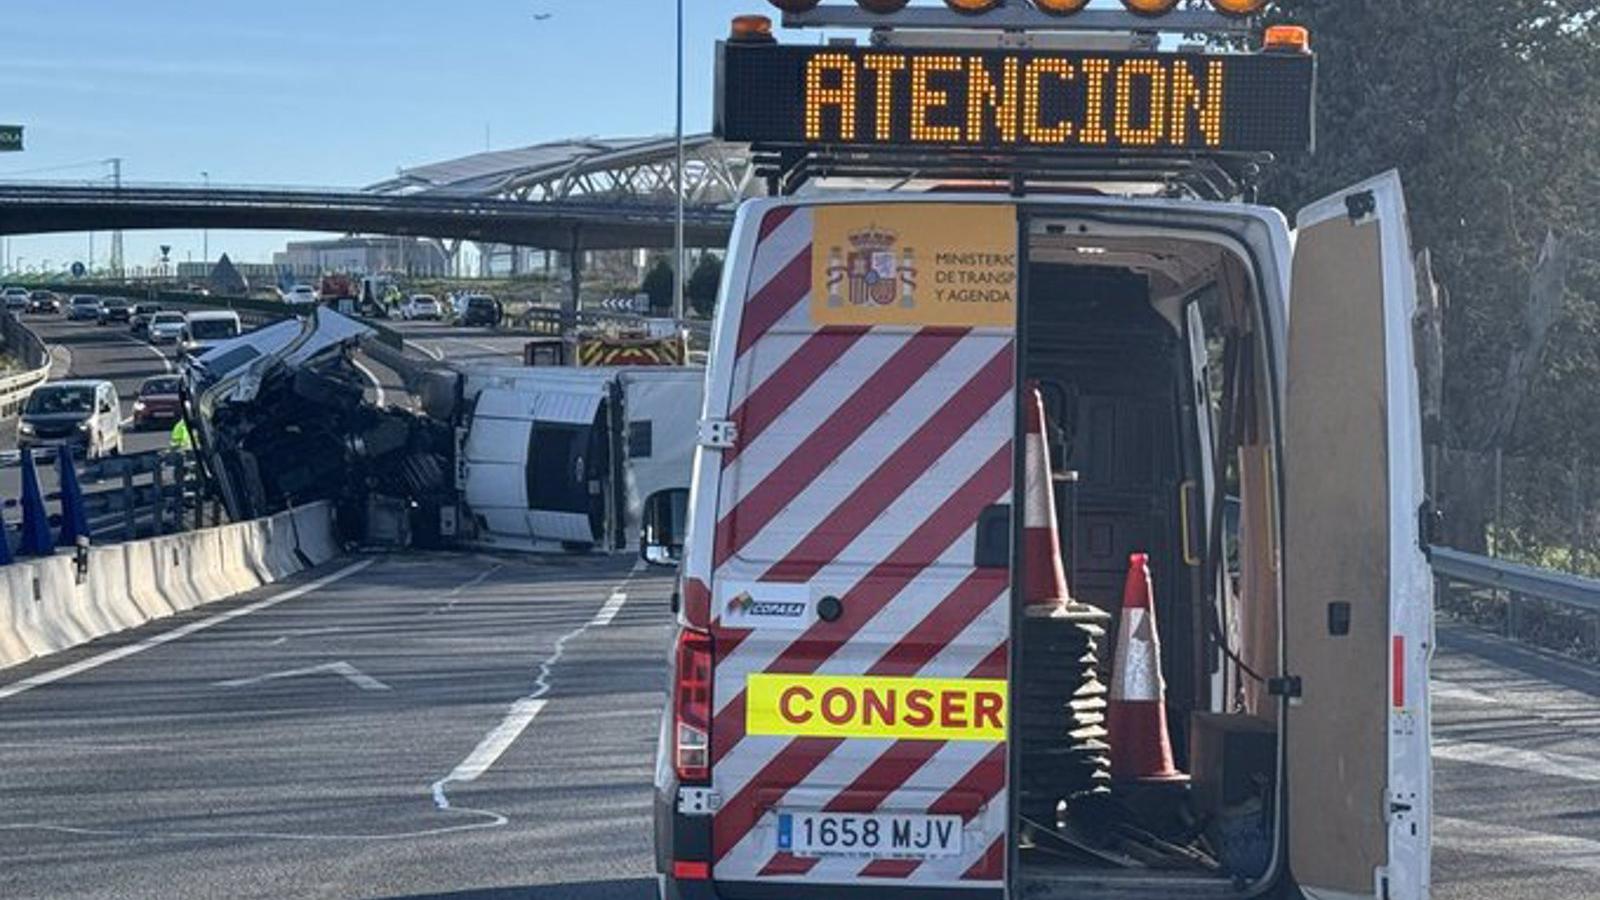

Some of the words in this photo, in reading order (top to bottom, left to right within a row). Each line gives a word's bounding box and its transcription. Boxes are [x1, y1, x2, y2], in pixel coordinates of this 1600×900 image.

[806, 53, 1223, 146] ATENCION
[936, 271, 956, 283] DE
[934, 290, 945, 302] Y
[946, 290, 1013, 302] AGENDA
[753, 603, 804, 615] COPASA
[779, 686, 1004, 729] CONSER
[804, 818, 881, 847] 1658
[892, 819, 953, 848] MJV
